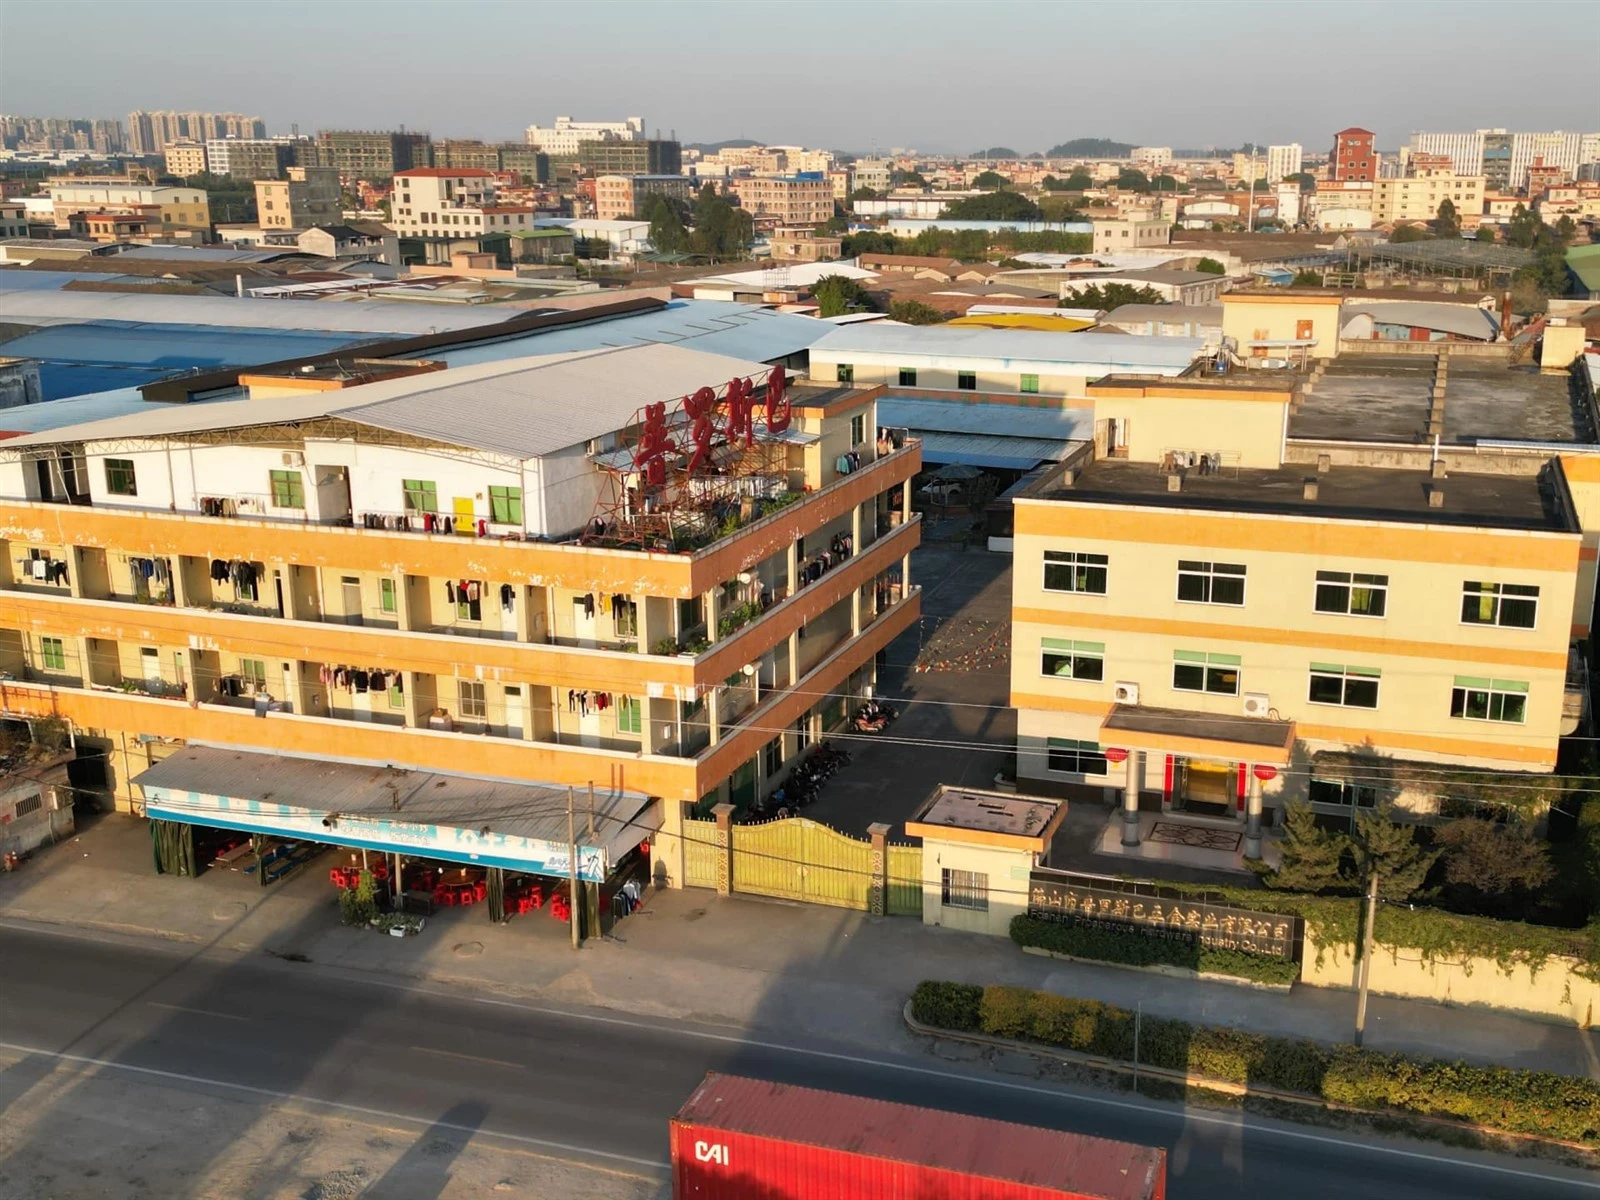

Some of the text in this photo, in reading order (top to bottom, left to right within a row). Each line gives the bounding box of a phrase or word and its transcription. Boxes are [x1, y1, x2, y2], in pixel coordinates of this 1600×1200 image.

[1030, 908, 1067, 922] Foshan
[1140, 926, 1192, 942] Hardware
[695, 1140, 730, 1166] CAI
